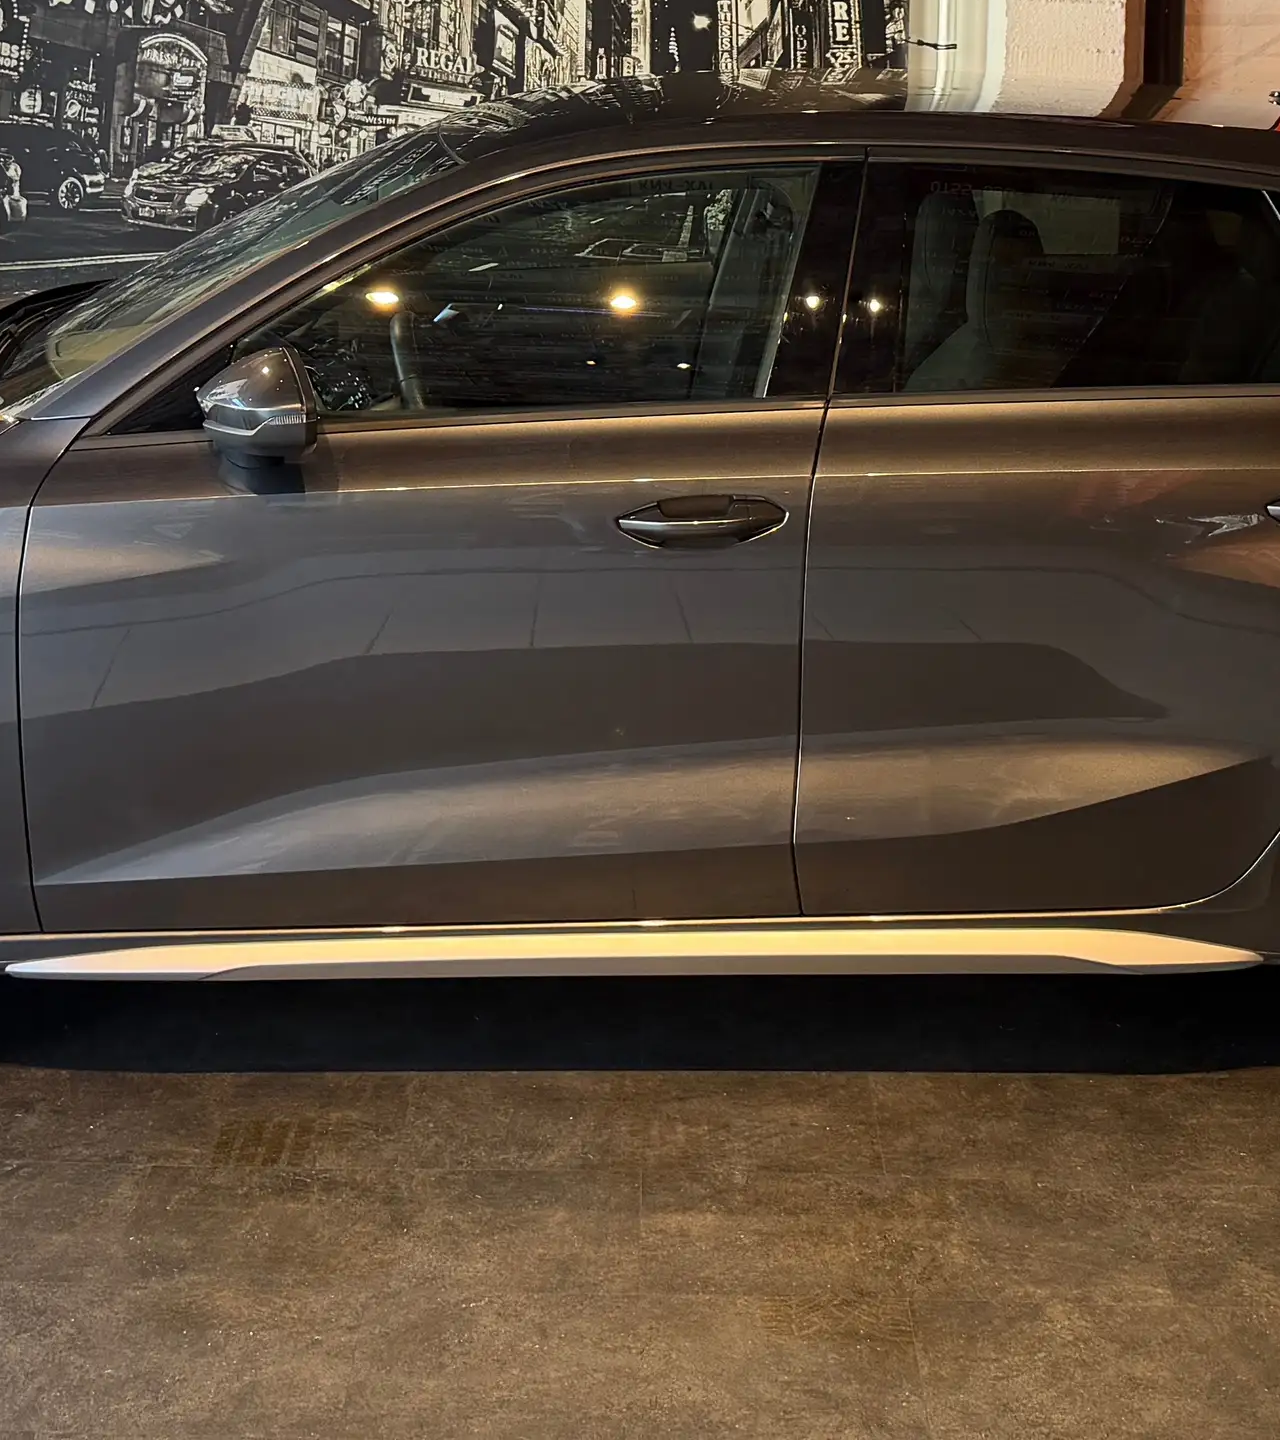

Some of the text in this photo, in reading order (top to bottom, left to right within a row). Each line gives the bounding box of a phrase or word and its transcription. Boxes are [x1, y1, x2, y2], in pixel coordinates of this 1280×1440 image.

[416, 47, 475, 74] REGAL
[835, 51, 851, 61] 25
[365, 114, 396, 125] WESTIN
